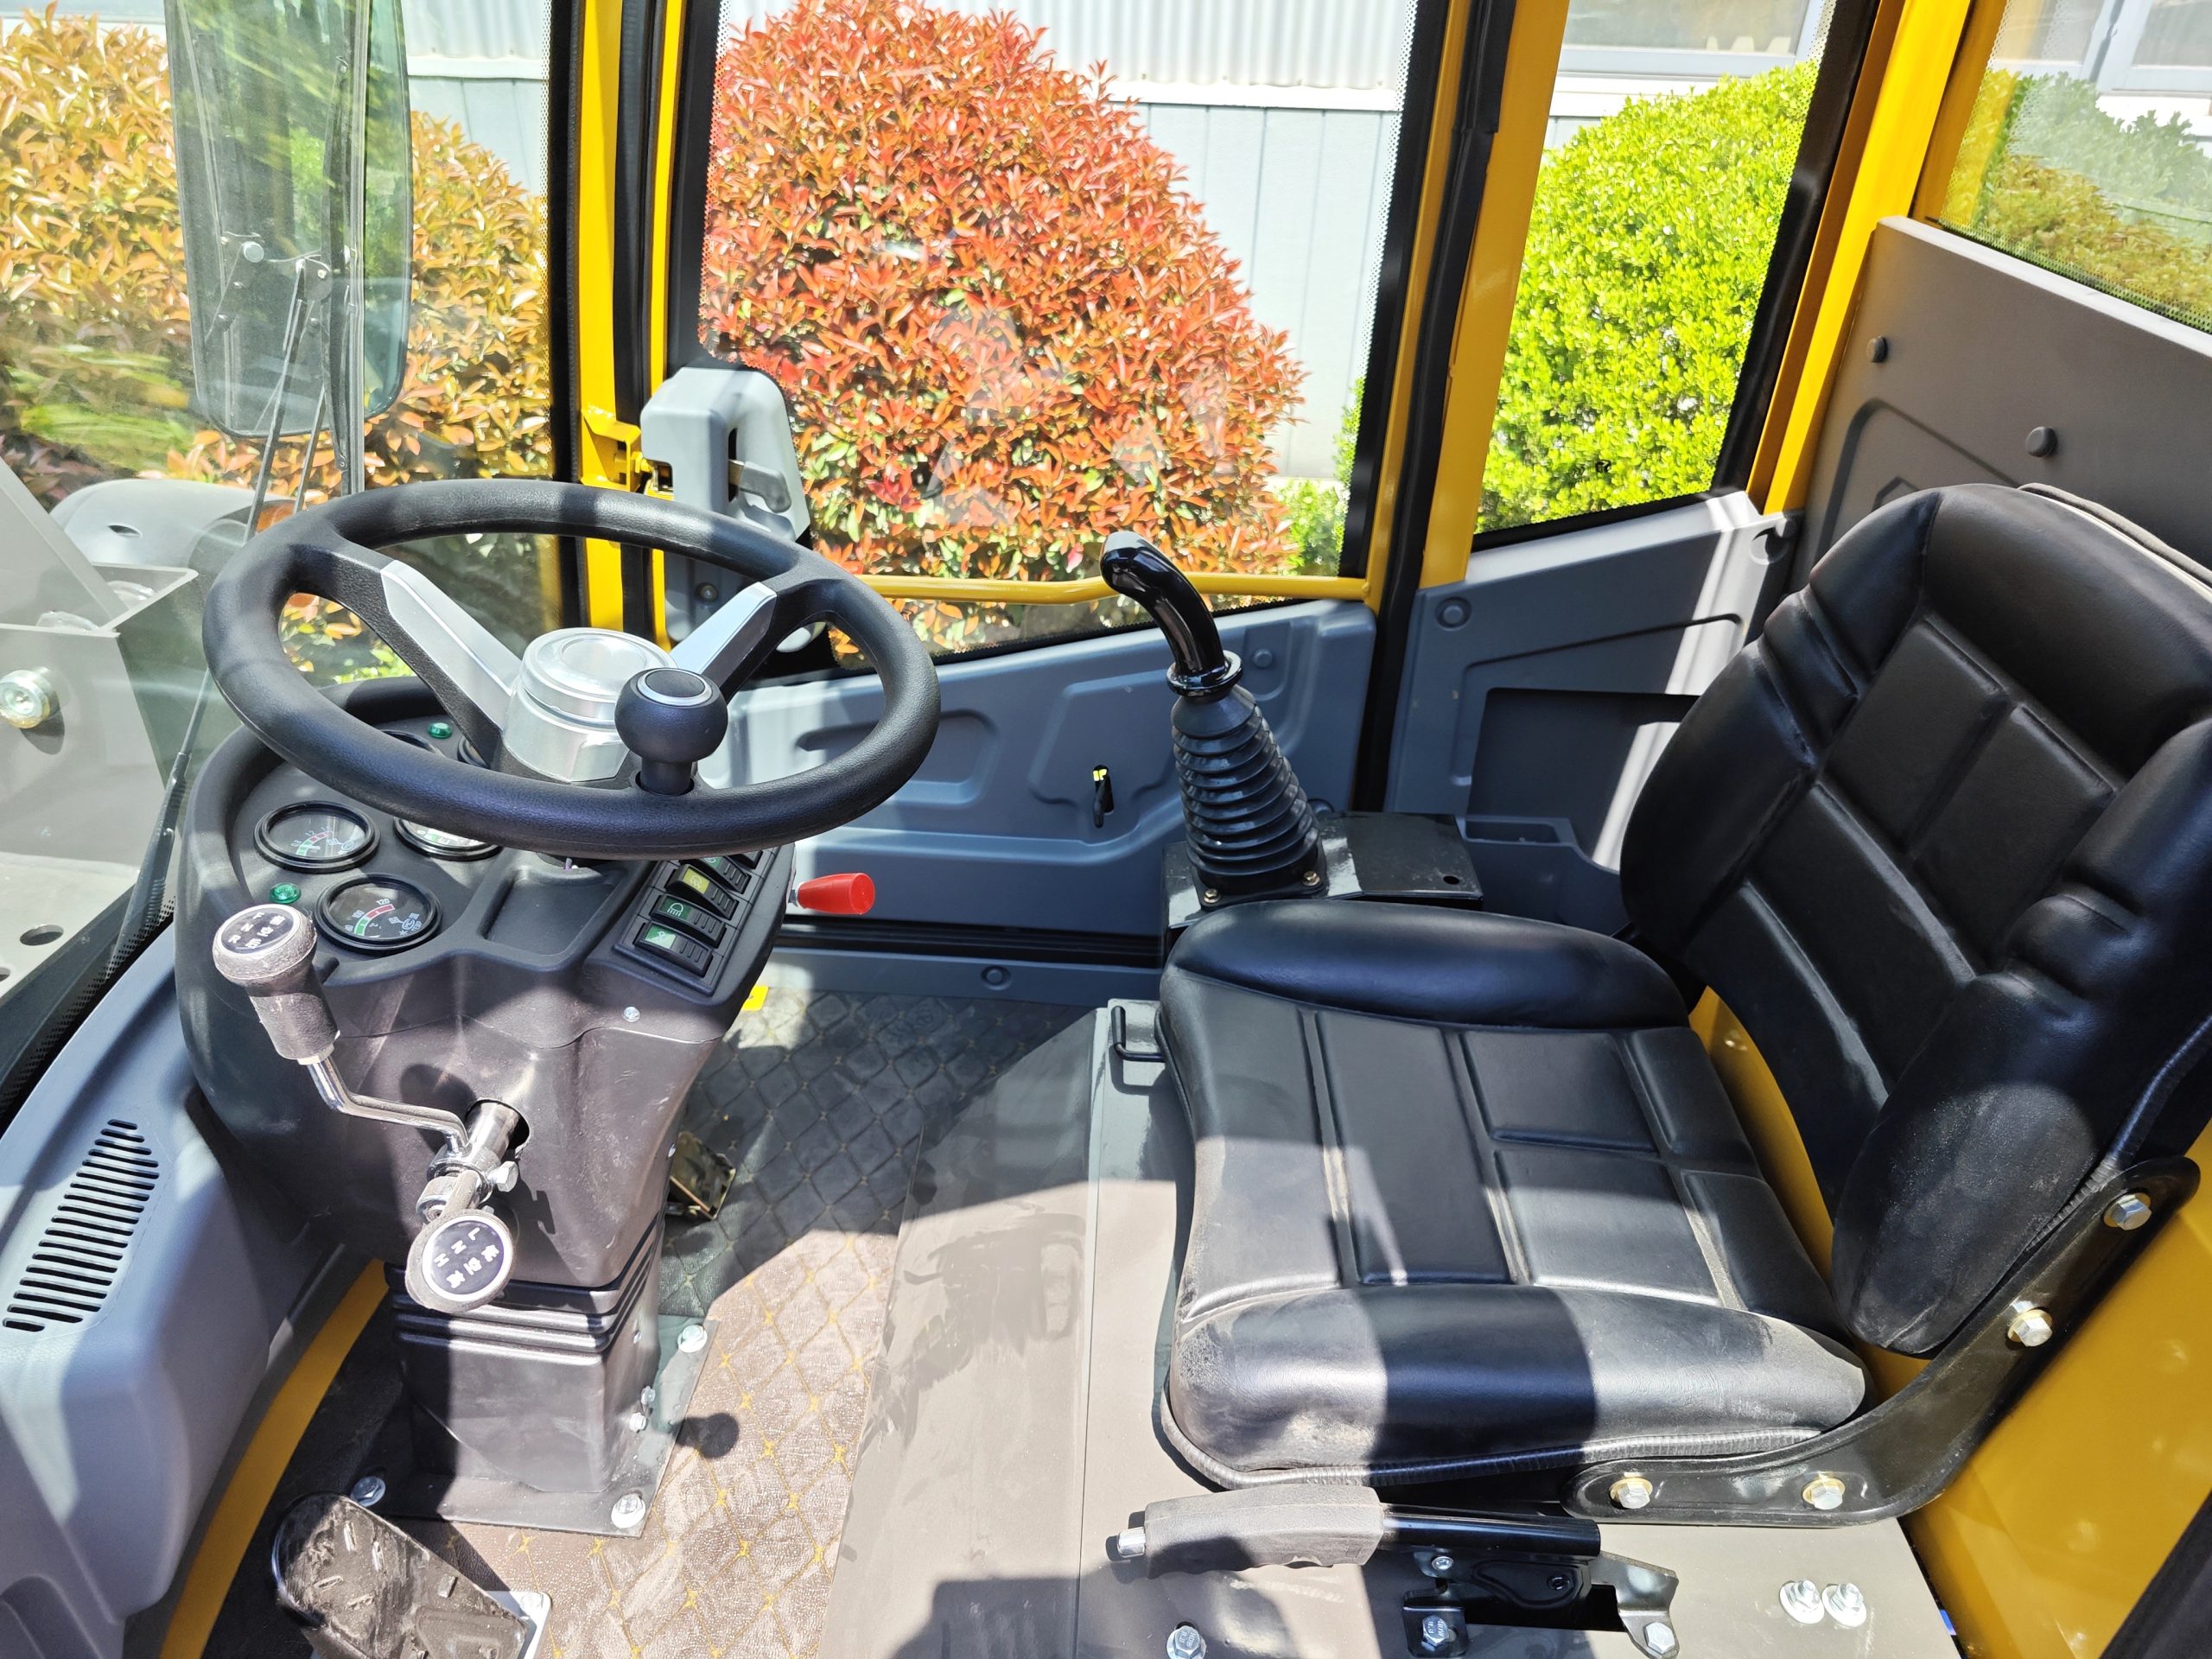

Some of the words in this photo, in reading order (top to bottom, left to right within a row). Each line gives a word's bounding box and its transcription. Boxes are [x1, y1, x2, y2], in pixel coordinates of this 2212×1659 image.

[252, 912, 265, 920] F
[240, 923, 254, 931] N
[228, 934, 241, 944] R
[467, 1227, 480, 1241] L
[434, 1253, 449, 1268] H
[451, 1240, 467, 1255] N
[463, 1256, 482, 1275] 空
